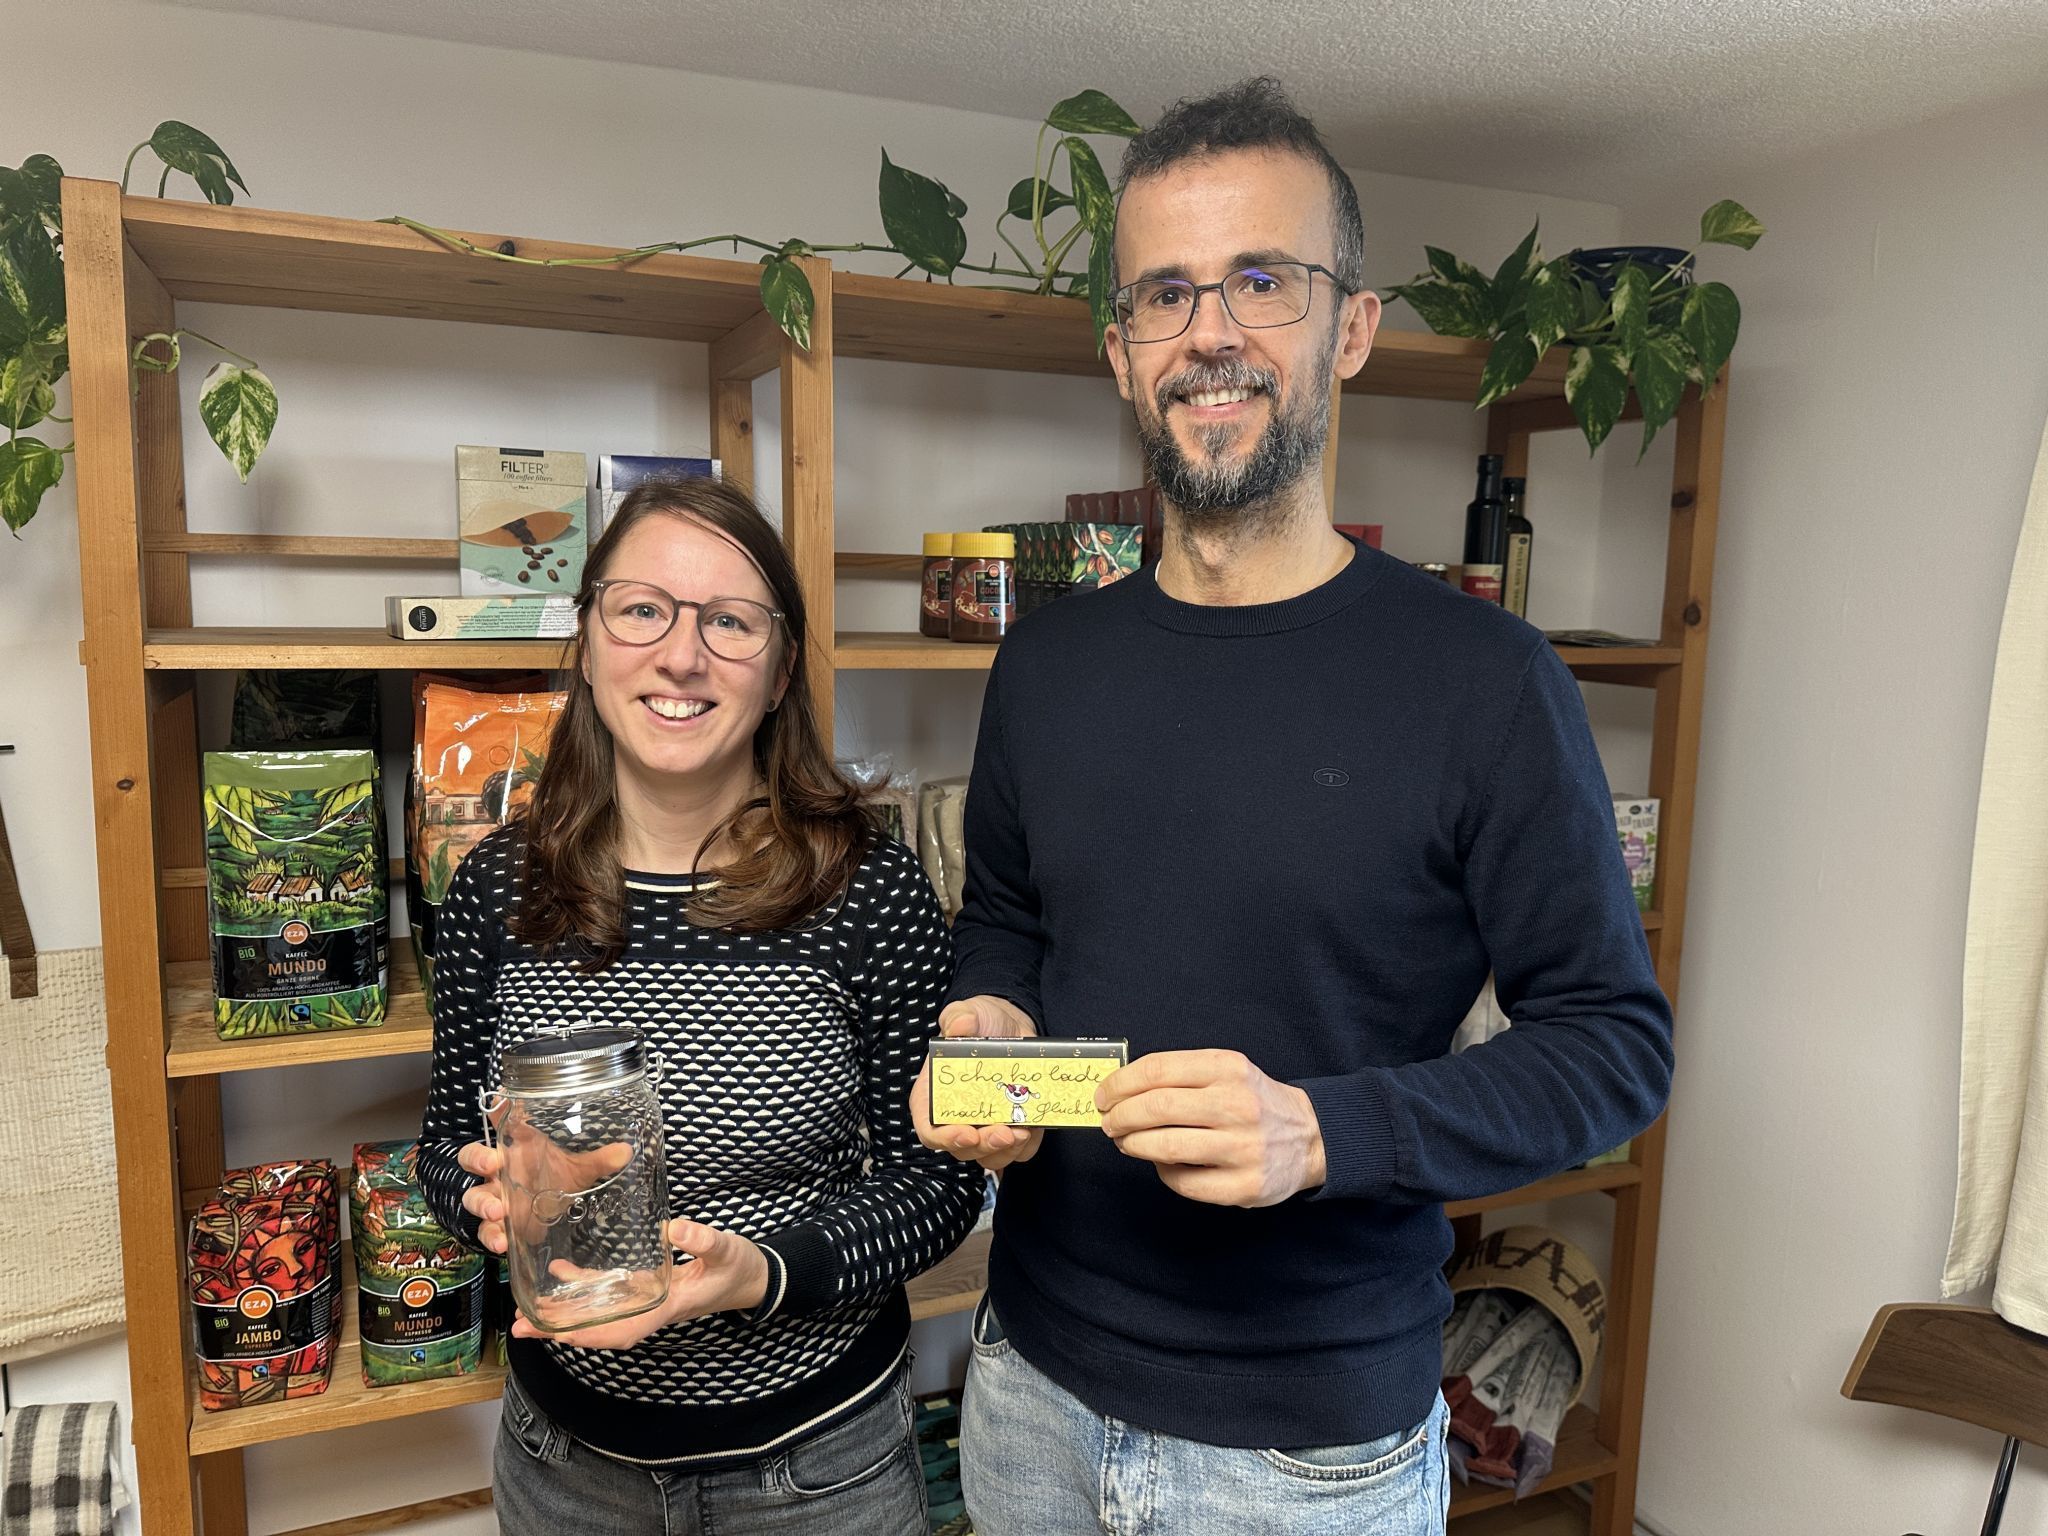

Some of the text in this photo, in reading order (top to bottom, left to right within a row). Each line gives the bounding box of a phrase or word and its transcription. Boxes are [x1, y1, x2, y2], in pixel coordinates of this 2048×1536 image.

[516, 474, 535, 482] coffee
[536, 474, 553, 482] filters
[287, 929, 304, 937] EZA
[238, 947, 256, 959] BIO
[285, 951, 308, 959] KAFFEE
[268, 958, 327, 976] MUNDO
[294, 980, 340, 989] HOCHLANDKAFFEE
[938, 1060, 1103, 1085] Schokolade
[941, 1098, 1095, 1123] macht glückli
[407, 1289, 429, 1299] EZA
[244, 1299, 268, 1309] EZA
[377, 1306, 391, 1315] BIO
[408, 1311, 428, 1319] KAFFEE
[214, 1318, 229, 1328] BIO
[394, 1316, 443, 1331] MUNDO
[235, 1329, 282, 1344] JAMBO
